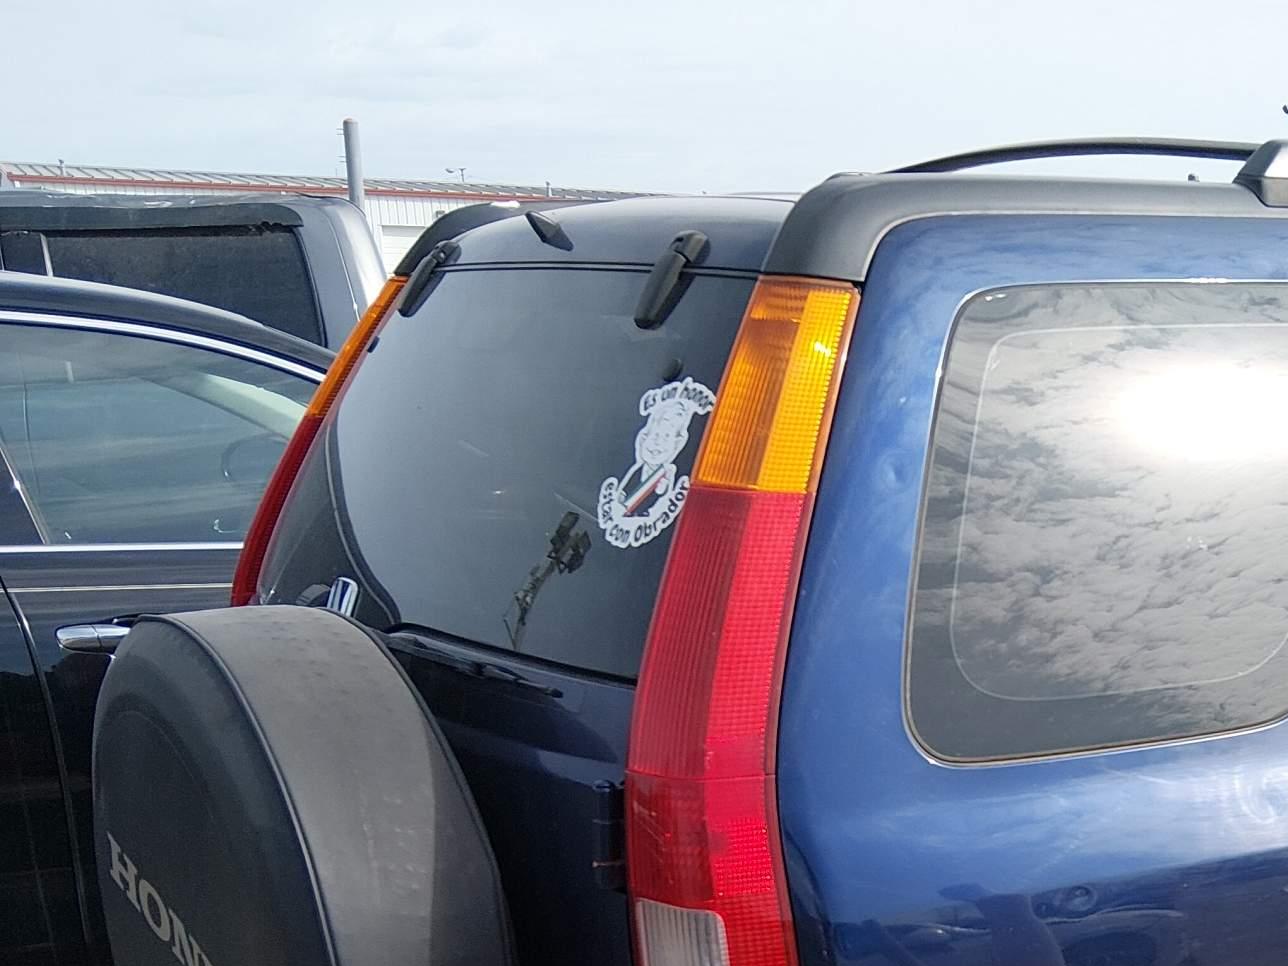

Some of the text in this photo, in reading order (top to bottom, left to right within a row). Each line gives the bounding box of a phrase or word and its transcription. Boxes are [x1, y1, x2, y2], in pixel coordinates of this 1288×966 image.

[643, 391, 658, 412] Es
[660, 386, 679, 401] un
[608, 523, 630, 543] con
[633, 480, 691, 543] Obrador
